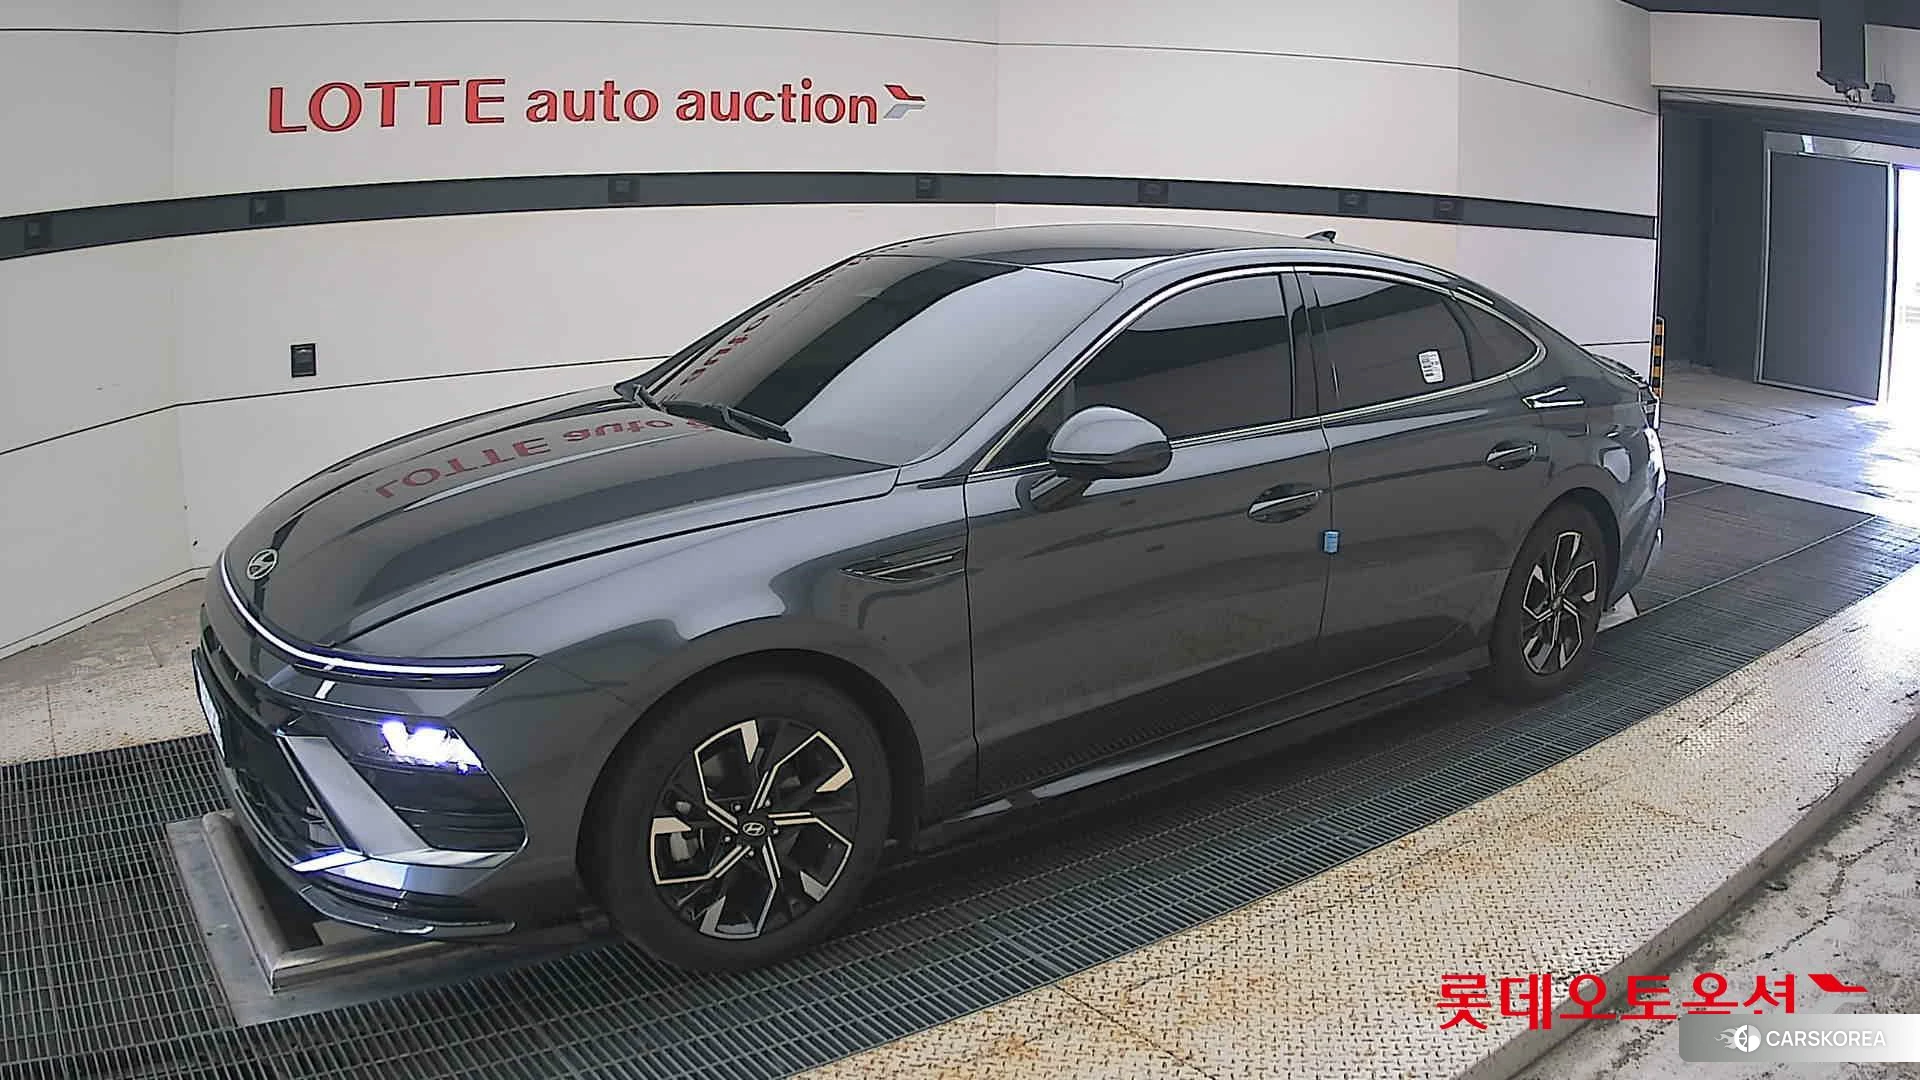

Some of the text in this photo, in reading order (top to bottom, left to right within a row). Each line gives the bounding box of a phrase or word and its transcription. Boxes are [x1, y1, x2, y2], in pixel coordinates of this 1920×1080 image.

[268, 79, 878, 134] LOTTE auto auction
